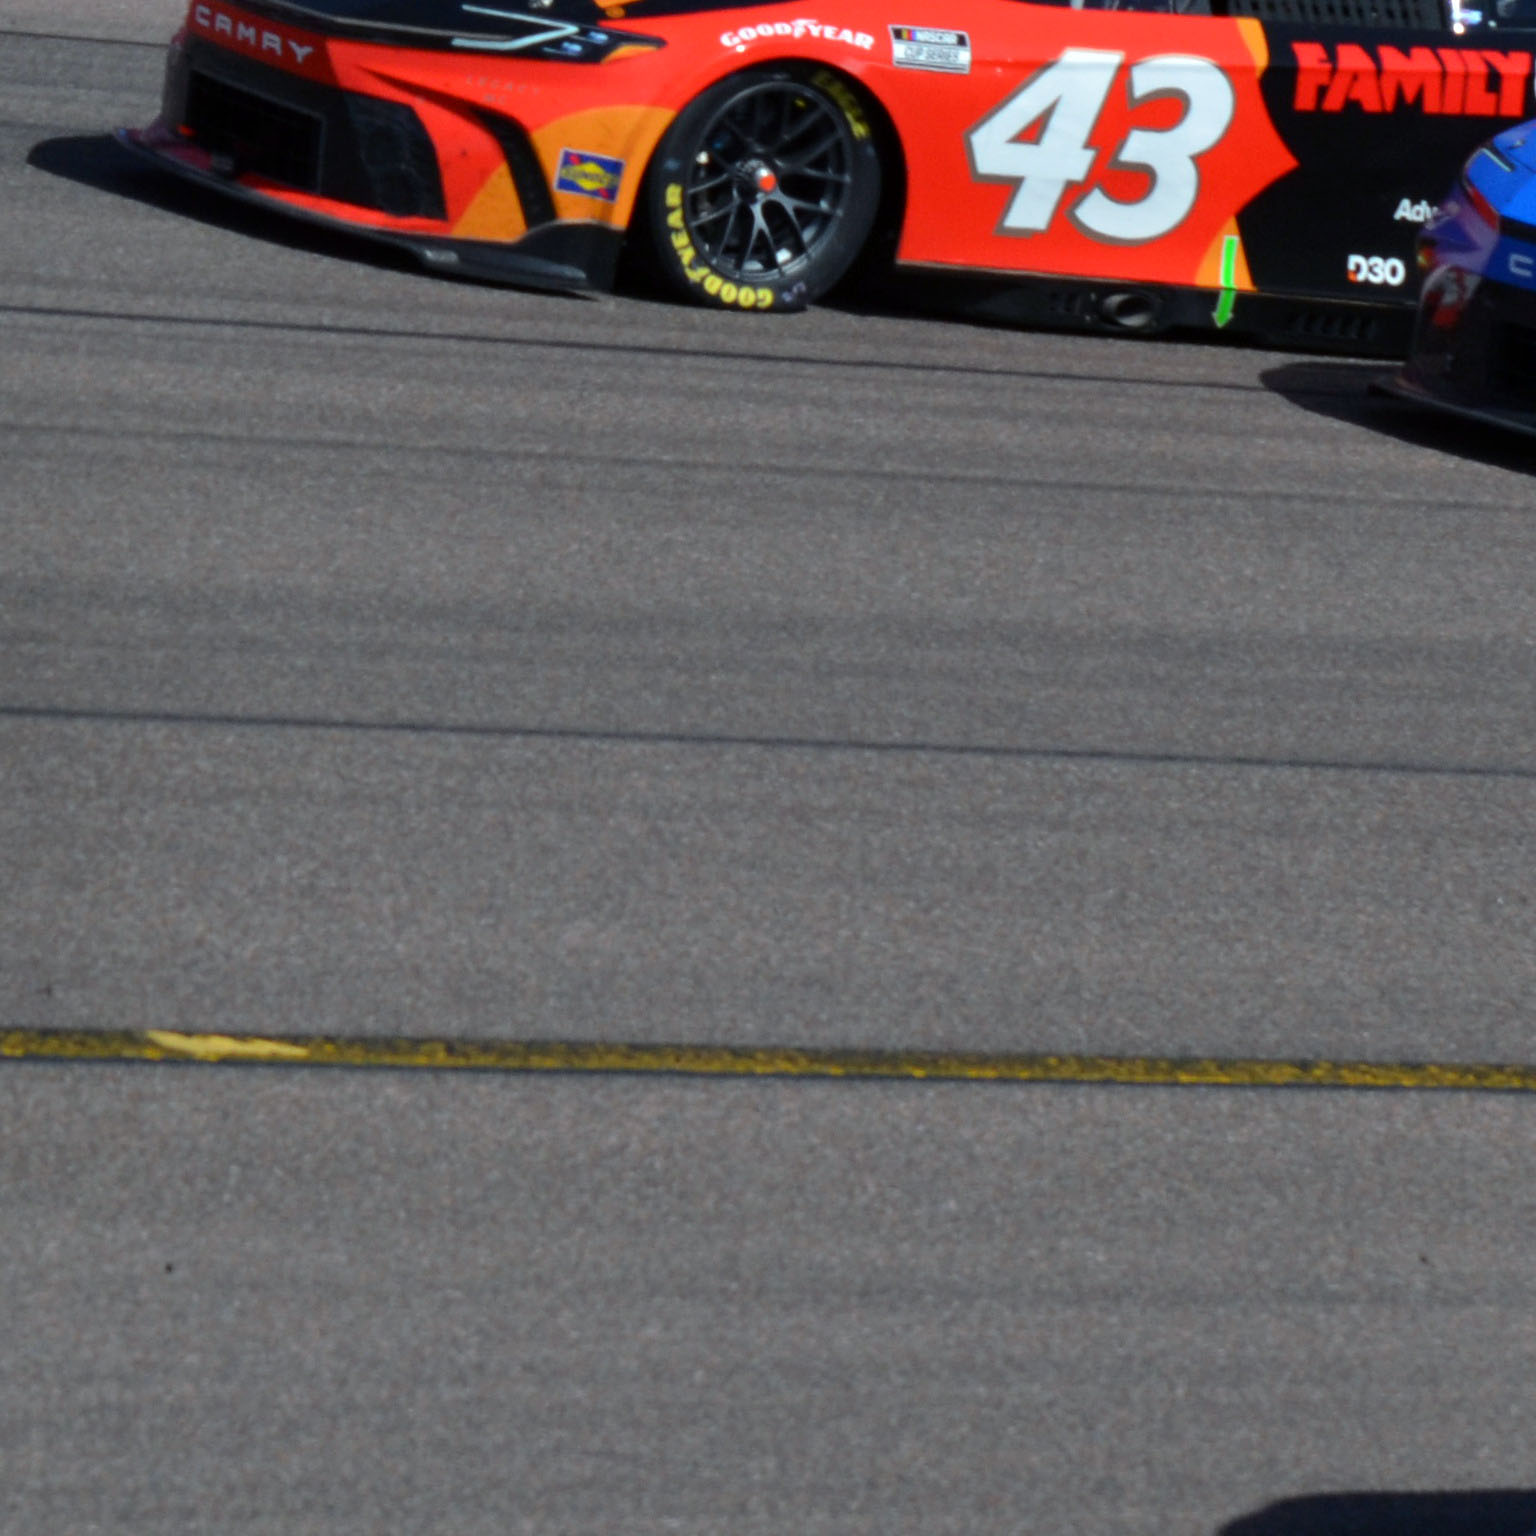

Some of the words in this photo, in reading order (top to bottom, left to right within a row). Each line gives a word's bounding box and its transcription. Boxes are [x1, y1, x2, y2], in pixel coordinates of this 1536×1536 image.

[193, 3, 314, 64] CAMRY
[719, 17, 875, 52] GOODYEAR
[1292, 41, 1532, 116] FAMILY
[965, 47, 1237, 247] 43
